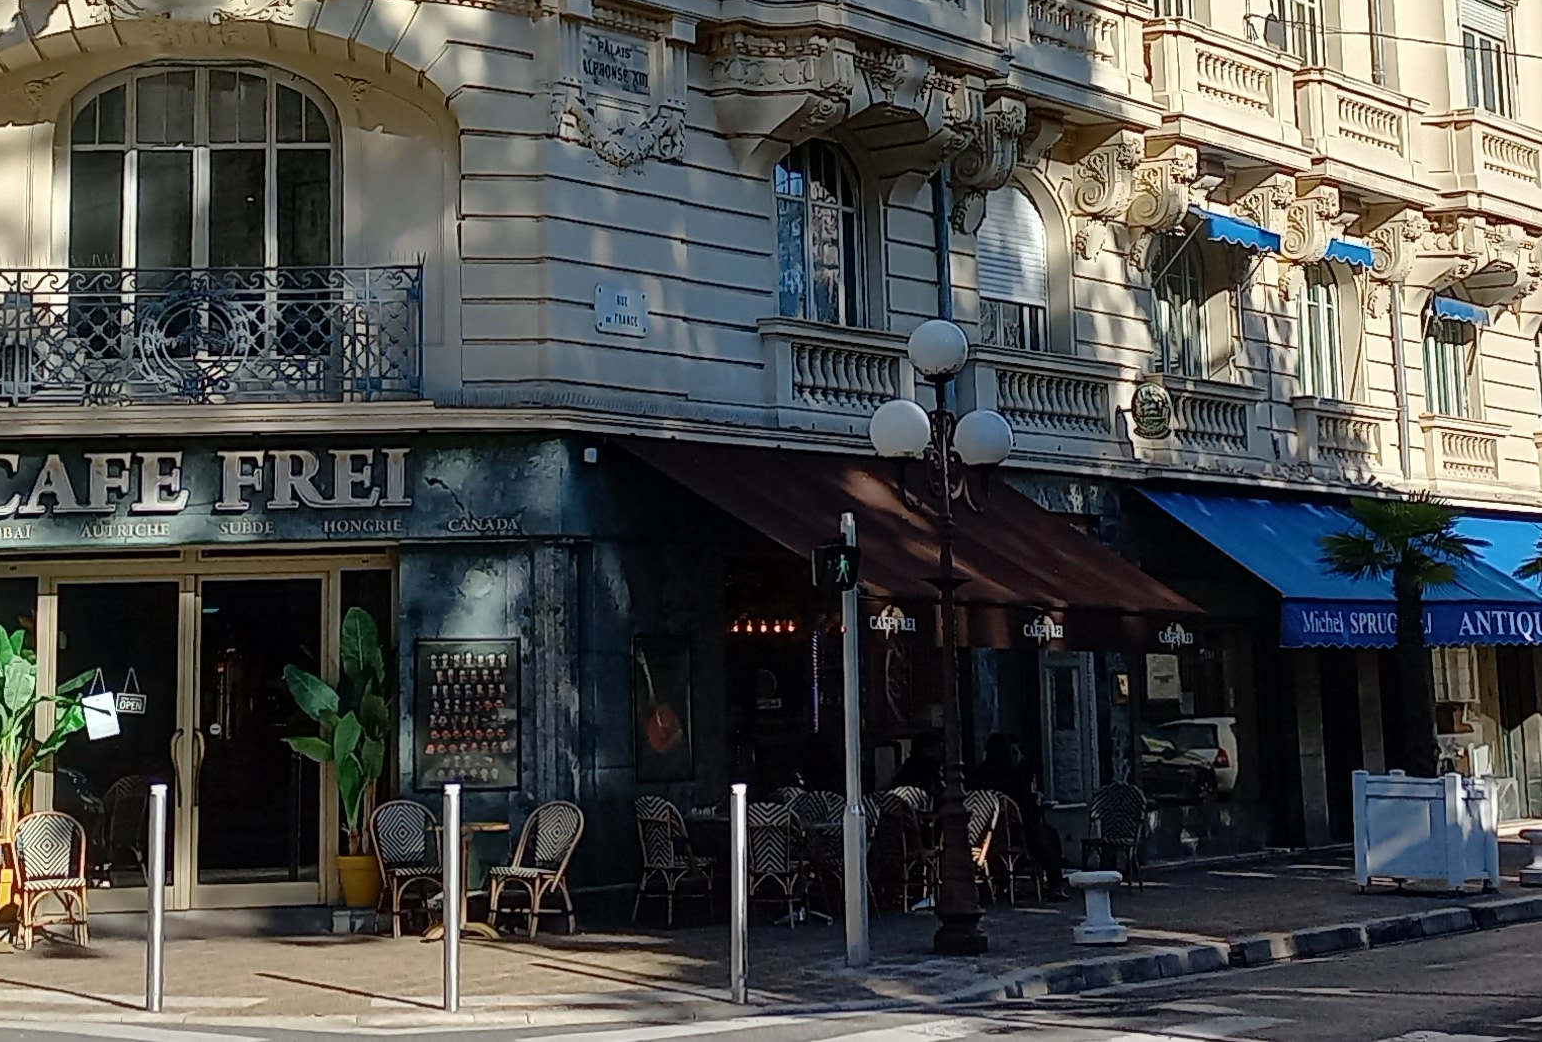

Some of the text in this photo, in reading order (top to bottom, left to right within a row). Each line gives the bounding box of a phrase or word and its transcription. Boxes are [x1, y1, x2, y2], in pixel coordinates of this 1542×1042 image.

[597, 39, 632, 59] PALAIS
[583, 58, 629, 83] ALPHONSE
[214, 448, 412, 510] FREI
[81, 523, 171, 538] AUTRICHE
[219, 517, 275, 534] SUÈDE
[323, 517, 403, 533] HONGRIE
[447, 516, 519, 533] CANADA
[1302, 610, 1343, 633] Michel
[119, 700, 142, 710] OPEN
